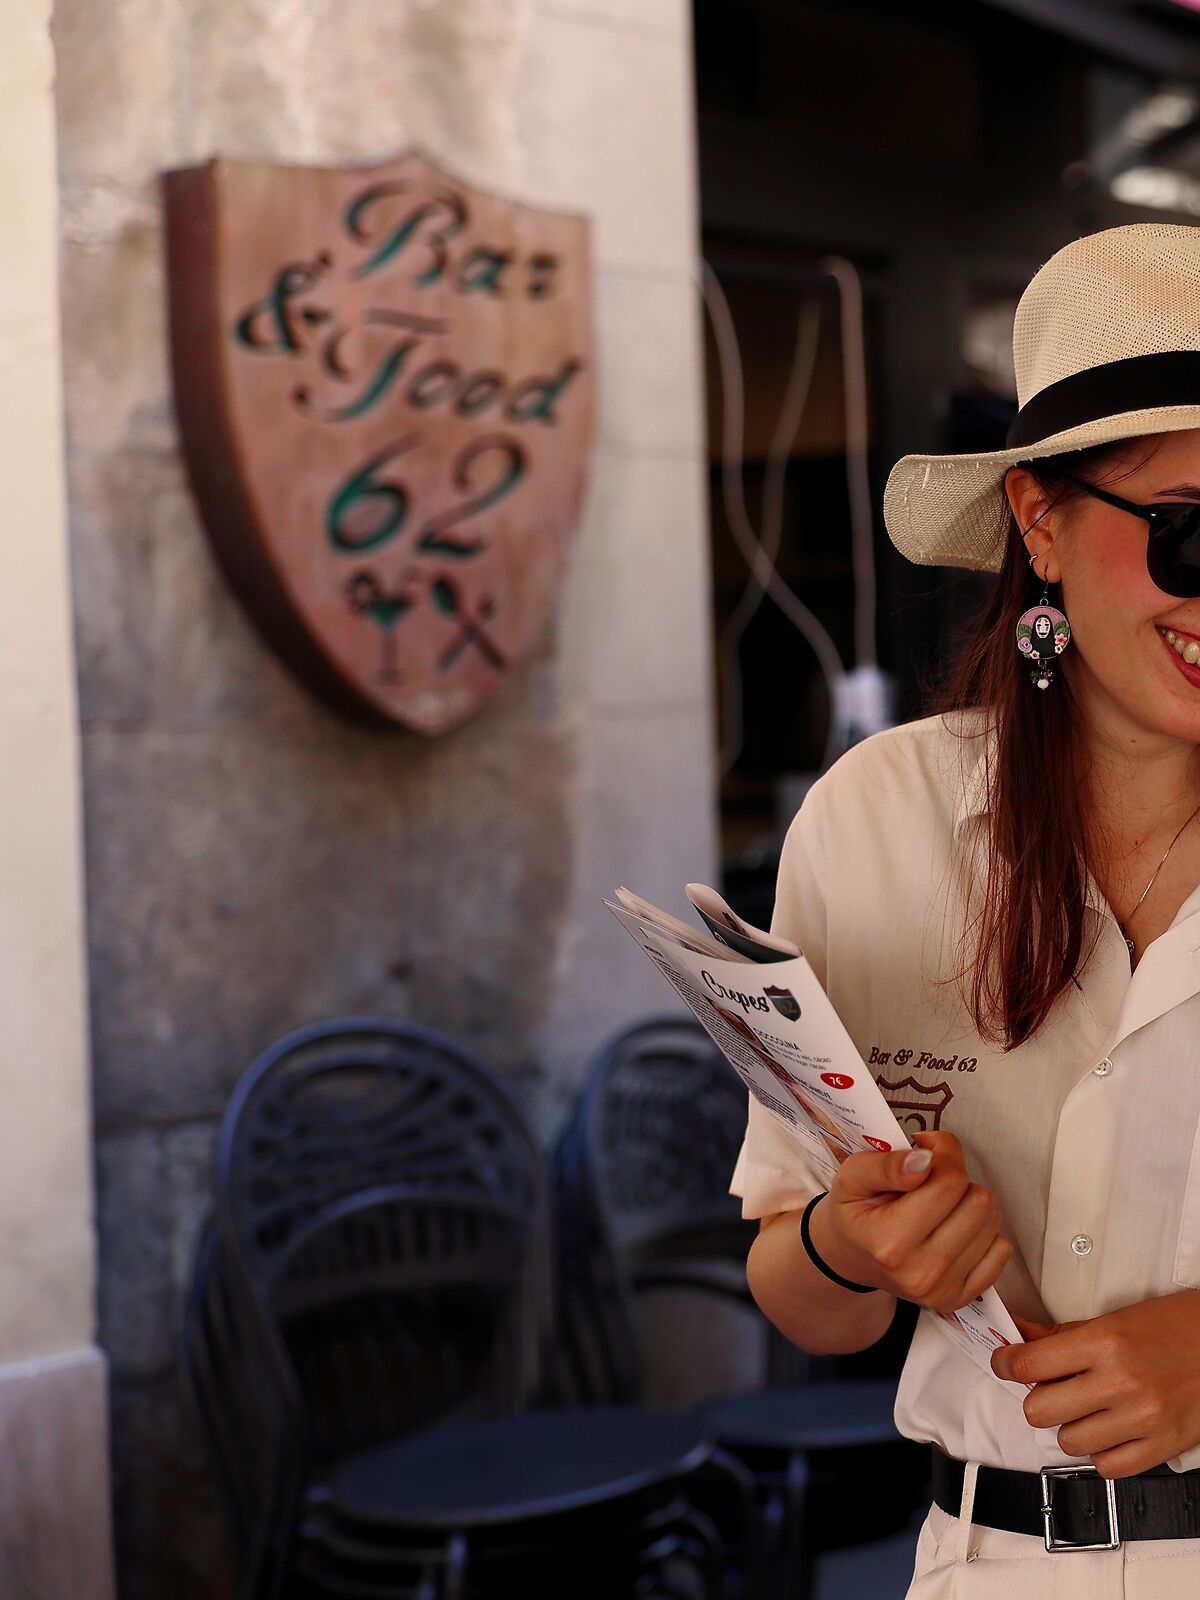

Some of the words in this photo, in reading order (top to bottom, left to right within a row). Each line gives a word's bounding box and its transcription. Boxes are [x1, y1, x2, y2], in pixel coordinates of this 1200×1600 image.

[342, 180, 560, 299] Bar
[232, 250, 334, 358] &
[322, 430, 528, 559] 62
[701, 970, 770, 1014] Crepes
[829, 1076, 844, 1086] 7€
[868, 1046, 891, 1066] Bar
[893, 1048, 914, 1066] &
[913, 1051, 958, 1072] Food
[957, 1056, 978, 1073] 62
